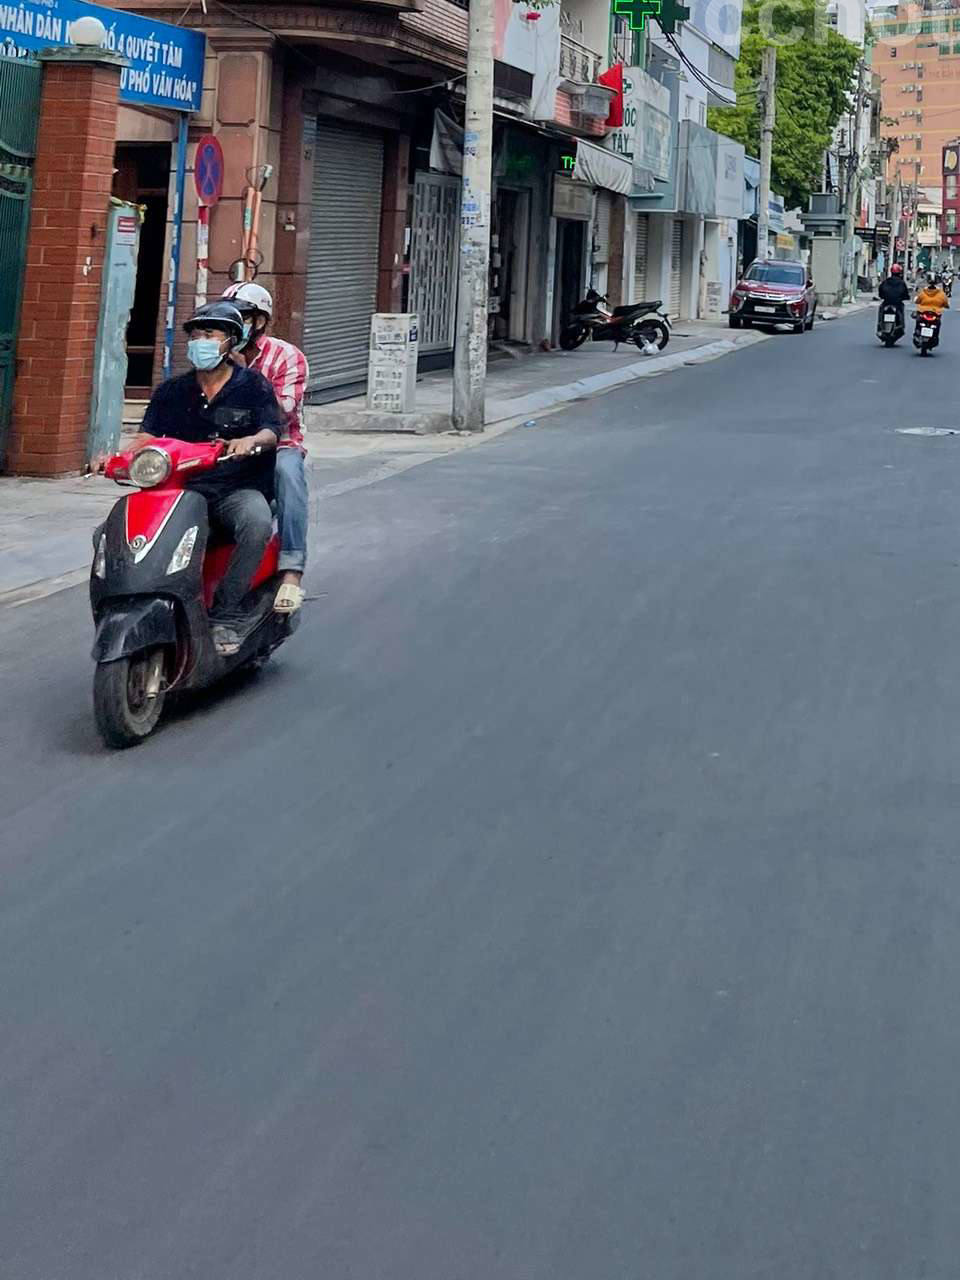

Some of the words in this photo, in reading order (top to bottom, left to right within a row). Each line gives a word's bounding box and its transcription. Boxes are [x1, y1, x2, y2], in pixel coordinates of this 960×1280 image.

[0, 3, 33, 36] NHÂN
[35, 10, 62, 42] DÂN
[118, 33, 124, 52] 4
[126, 32, 161, 63] QUYẾT
[162, 41, 182, 68] TÂM
[128, 64, 152, 94] PHỐ
[152, 71, 172, 99] VĂN
[612, 129, 630, 154] TÂY
